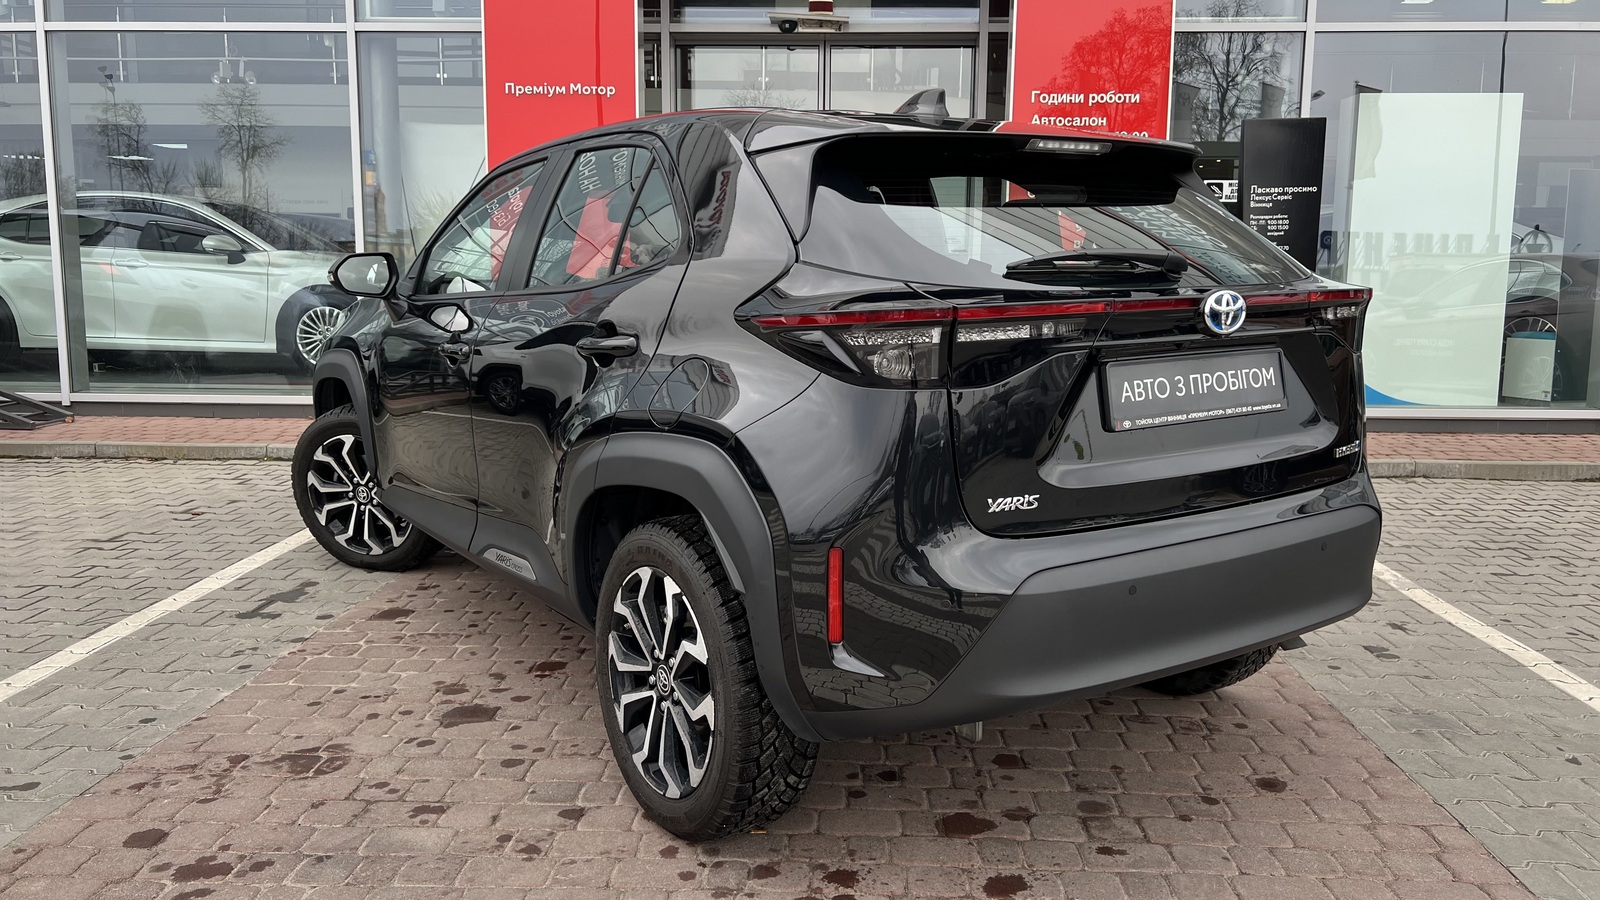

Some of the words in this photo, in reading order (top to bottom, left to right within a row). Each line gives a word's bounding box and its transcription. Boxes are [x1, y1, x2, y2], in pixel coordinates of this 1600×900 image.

[505, 82, 566, 97] Преміум
[570, 83, 616, 97] Мотор
[1031, 91, 1084, 105] Години
[1089, 91, 1140, 106] роботи
[1031, 114, 1107, 126] Автосалон
[1250, 185, 1283, 194] Ласкаво
[1284, 186, 1318, 194] просимо
[1121, 377, 1170, 403] АВТО
[1175, 375, 1186, 397] З
[1189, 366, 1276, 395] ПРОБІГОМ
